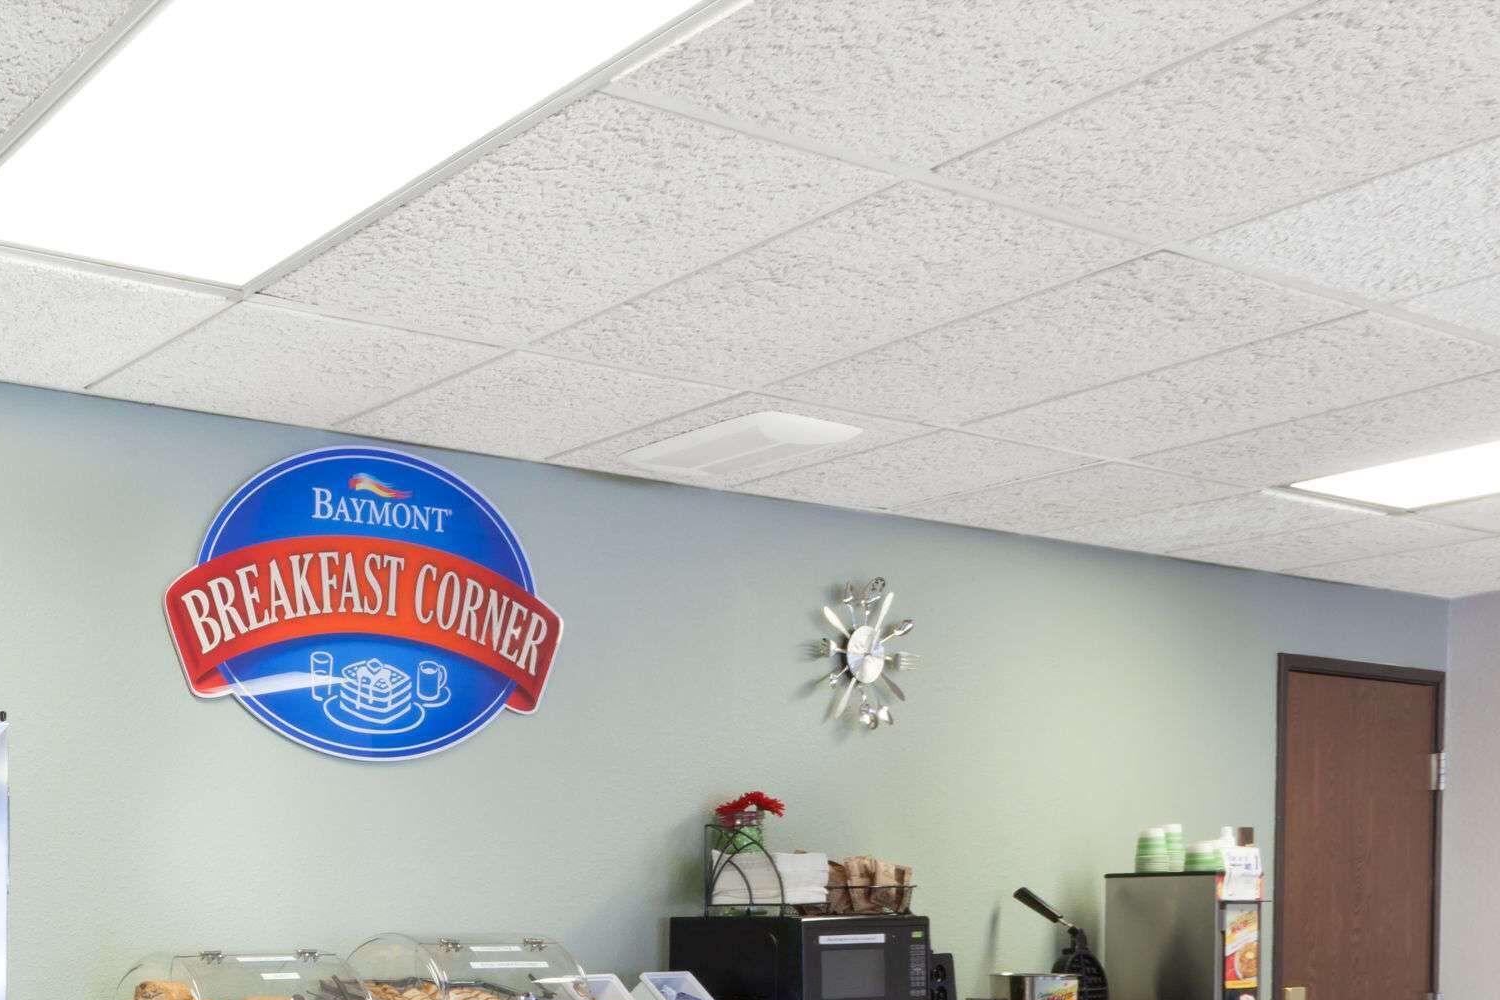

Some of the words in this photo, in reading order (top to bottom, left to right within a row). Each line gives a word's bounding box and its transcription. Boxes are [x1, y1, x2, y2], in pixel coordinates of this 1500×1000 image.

[311, 487, 450, 533] BAYMONT
[181, 550, 405, 655] BREAKFAST
[414, 563, 549, 677] CORNER
